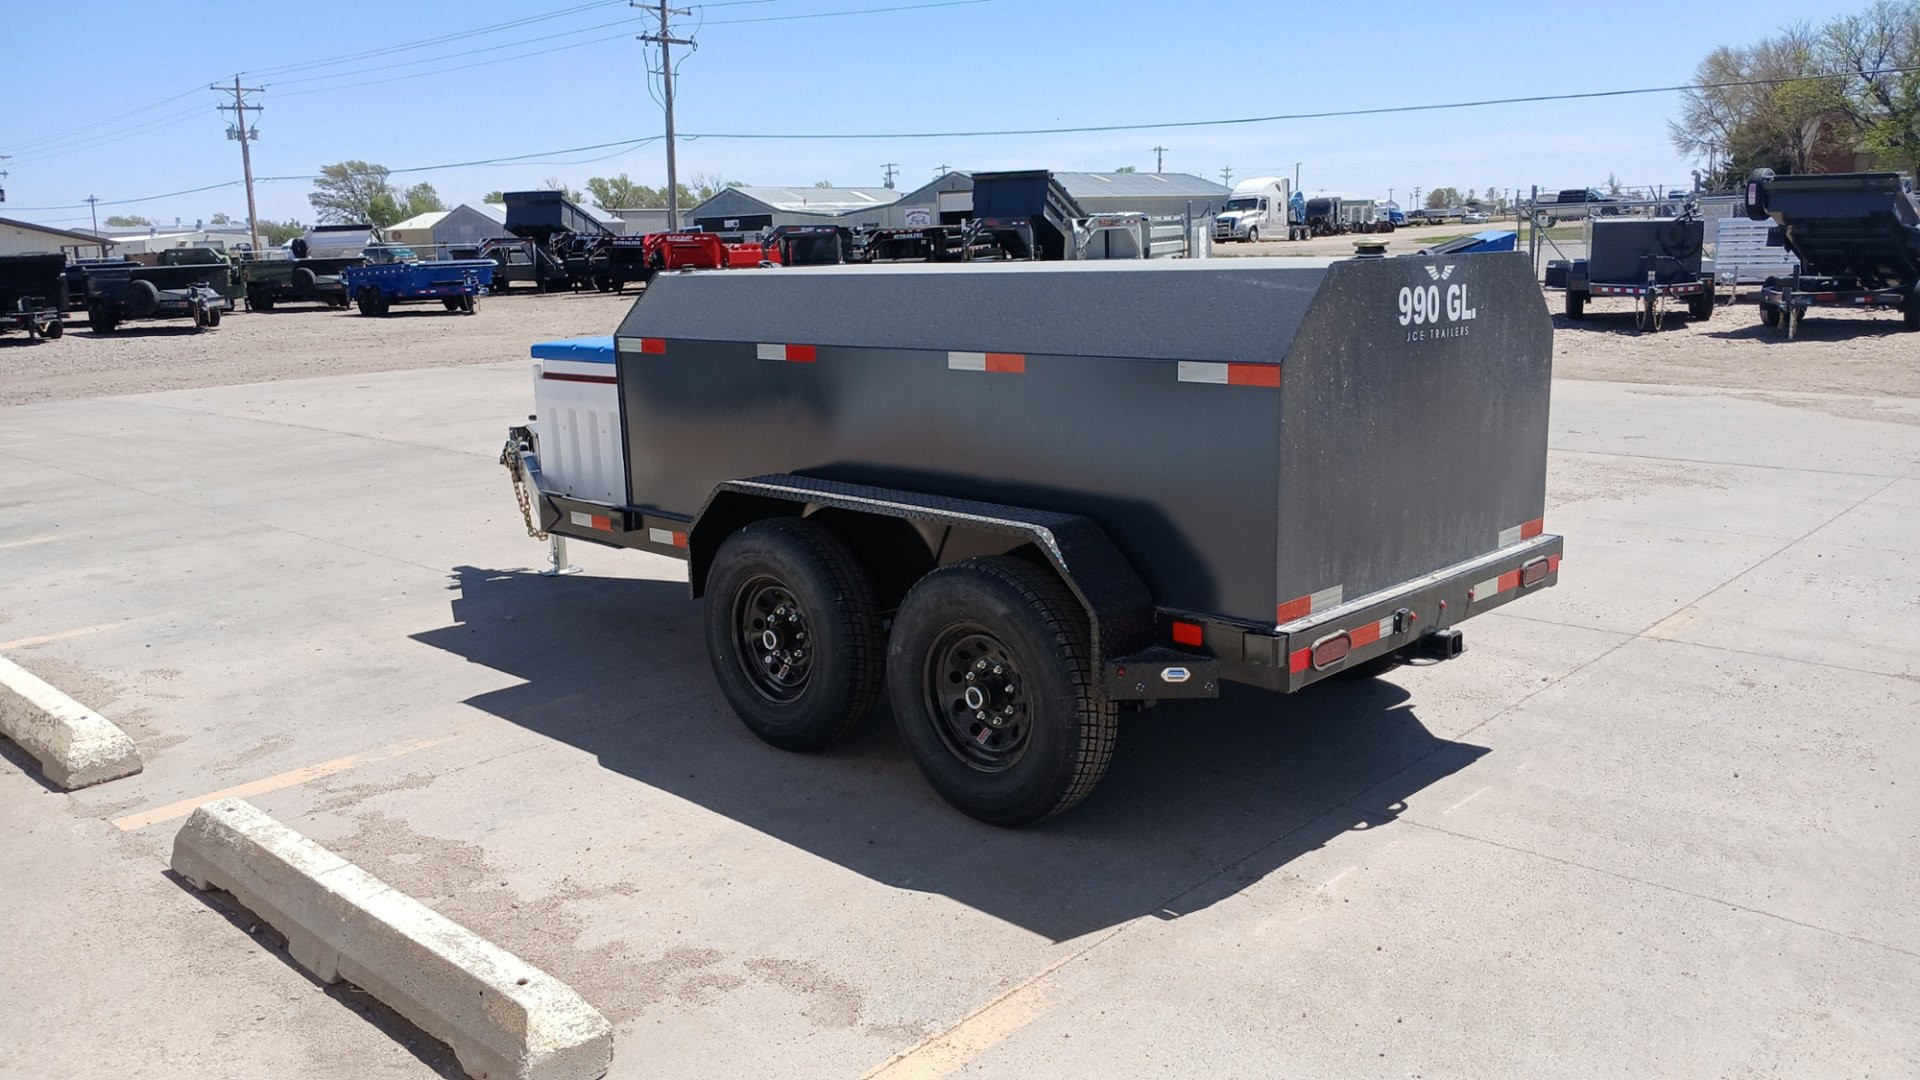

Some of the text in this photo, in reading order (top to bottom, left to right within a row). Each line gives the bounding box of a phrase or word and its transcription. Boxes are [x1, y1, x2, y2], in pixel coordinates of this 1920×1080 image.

[1398, 284, 1477, 326] 990 GL.
[1406, 326, 1469, 342] JCE TRAILERS
